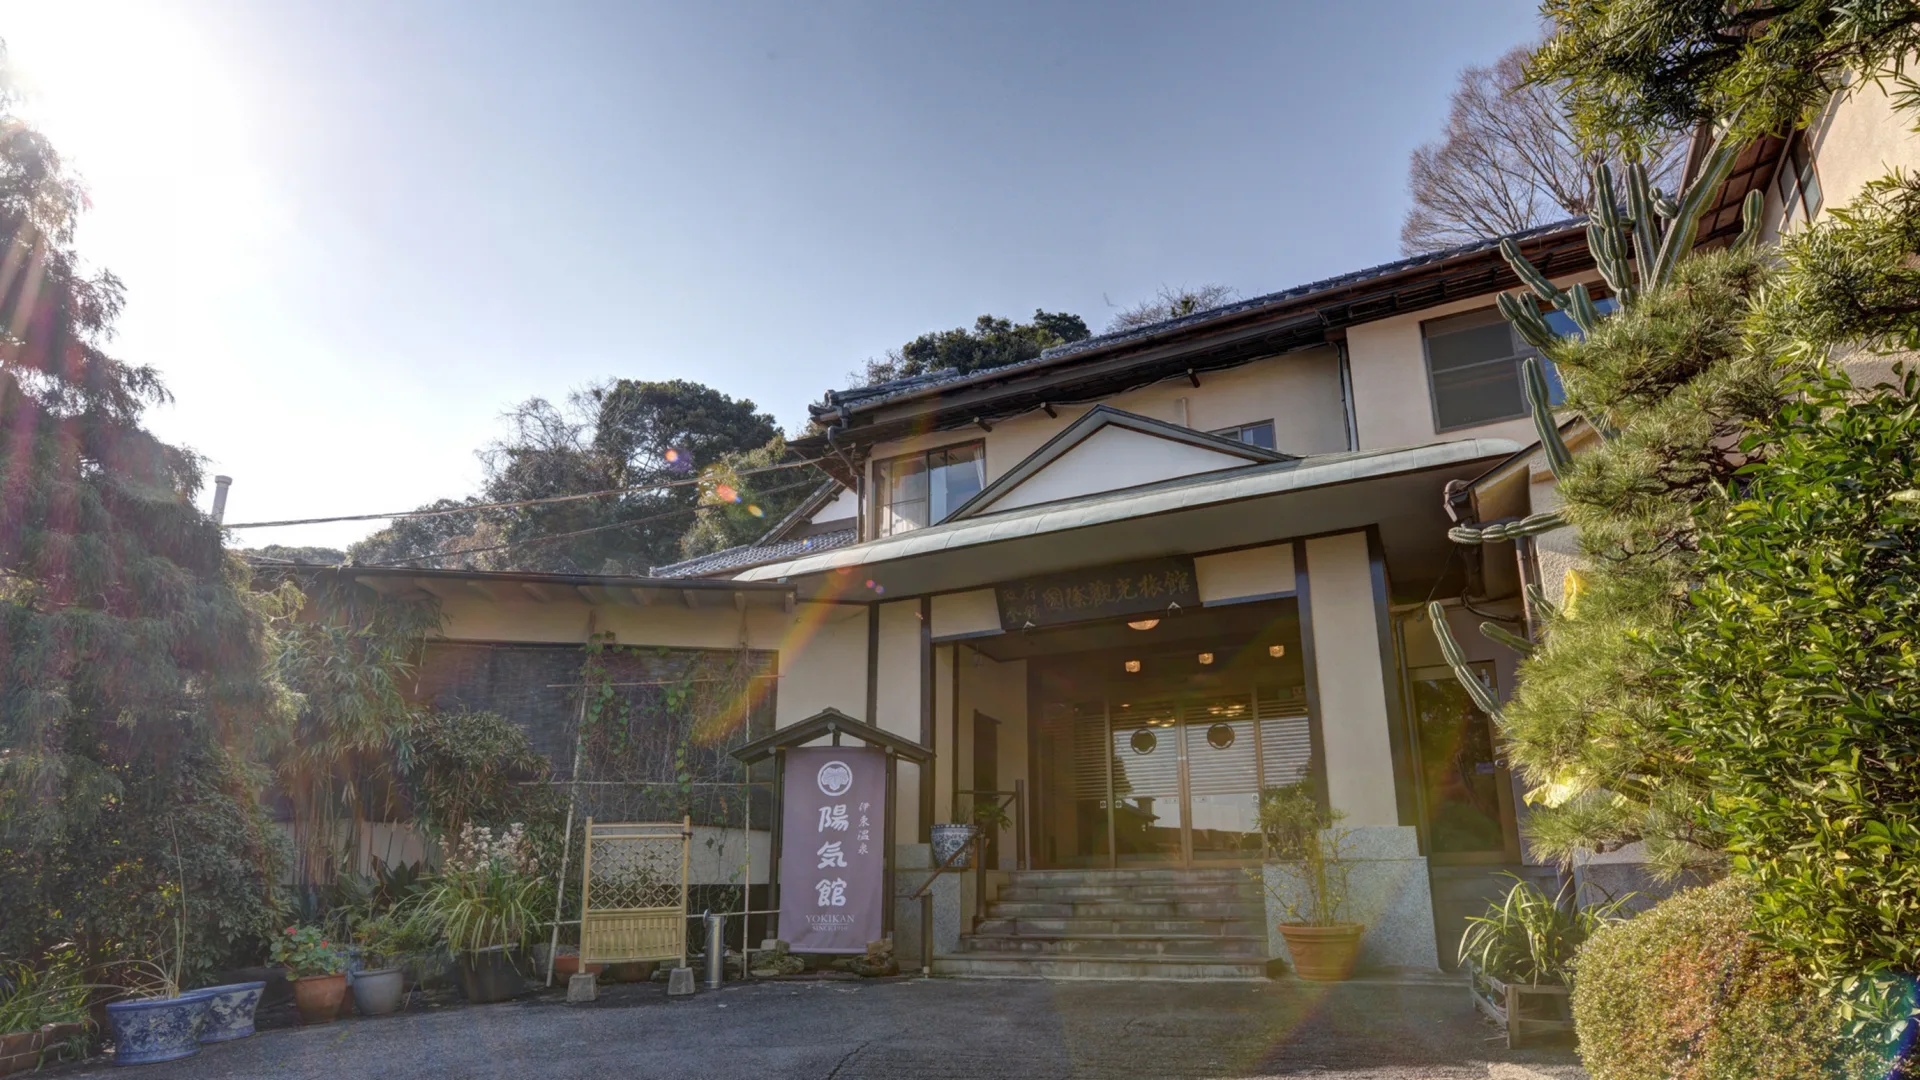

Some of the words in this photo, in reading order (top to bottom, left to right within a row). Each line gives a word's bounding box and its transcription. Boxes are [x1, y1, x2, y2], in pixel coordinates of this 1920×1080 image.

[857, 801, 871, 855] 伊東温泉
[815, 804, 849, 907] 陽気館
[805, 914, 855, 923] YOKIKAN
